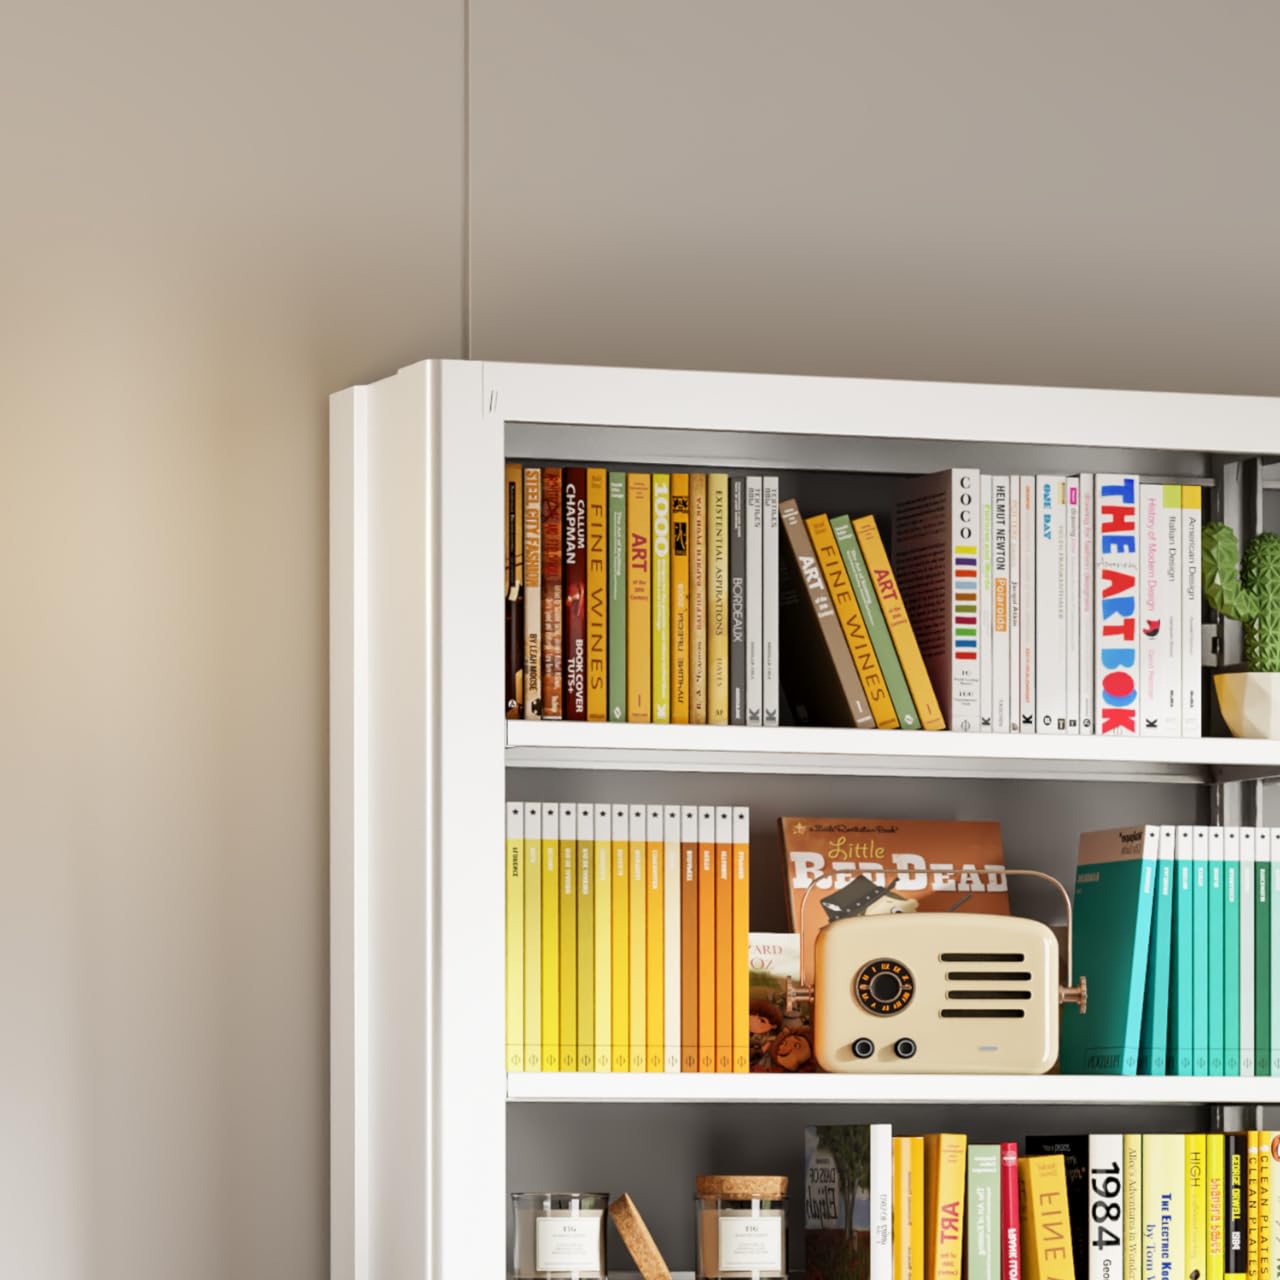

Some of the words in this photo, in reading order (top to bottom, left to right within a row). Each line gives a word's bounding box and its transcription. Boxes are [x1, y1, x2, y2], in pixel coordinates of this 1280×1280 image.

[566, 483, 576, 564] CHAPMAN
[577, 499, 585, 549] CALLUM
[654, 482, 668, 557] 1000
[715, 490, 723, 561] EXISTENTIAL
[995, 485, 1006, 525] HELMUT
[1101, 478, 1136, 554] THE
[591, 504, 603, 572] FINE
[632, 533, 647, 572] ART
[995, 528, 1006, 571] NEWTON
[1168, 516, 1177, 545] Italian
[1188, 516, 1197, 564] American
[799, 555, 824, 591] ART
[873, 569, 899, 601] ART
[1168, 547, 1177, 582] Design
[1188, 566, 1197, 600] Design
[715, 566, 723, 636] ASPIRATIONS
[732, 577, 742, 643] BORDEAUX
[1101, 569, 1136, 641] ART
[591, 588, 603, 690] WINES
[820, 545, 851, 605] FINE
[846, 614, 885, 702] WINES
[567, 656, 575, 694] TUTS+
[576, 639, 584, 673] BOOK
[576, 674, 584, 713] COVER
[1101, 648, 1137, 734] BOOK
[828, 836, 886, 861] Little
[790, 851, 886, 890] RED
[892, 853, 1008, 893] DEAD
[749, 944, 782, 955] ARD
[1128, 1148, 1137, 1176] Alice's
[1191, 1152, 1201, 1187] HIGH
[1248, 1157, 1257, 1208] CLEAN
[1260, 1156, 1269, 1206] CLEAN
[1091, 1161, 1121, 1251] 1984
[1128, 1178, 1137, 1229] Adventures
[1161, 1193, 1172, 1212] THE
[1145, 1224, 1156, 1238] by
[1161, 1215, 1172, 1259] ELECTRIC
[1248, 1217, 1257, 1277] PLATES
[1260, 1215, 1269, 1275] PLATES
[1145, 1243, 1156, 1272] Tom
